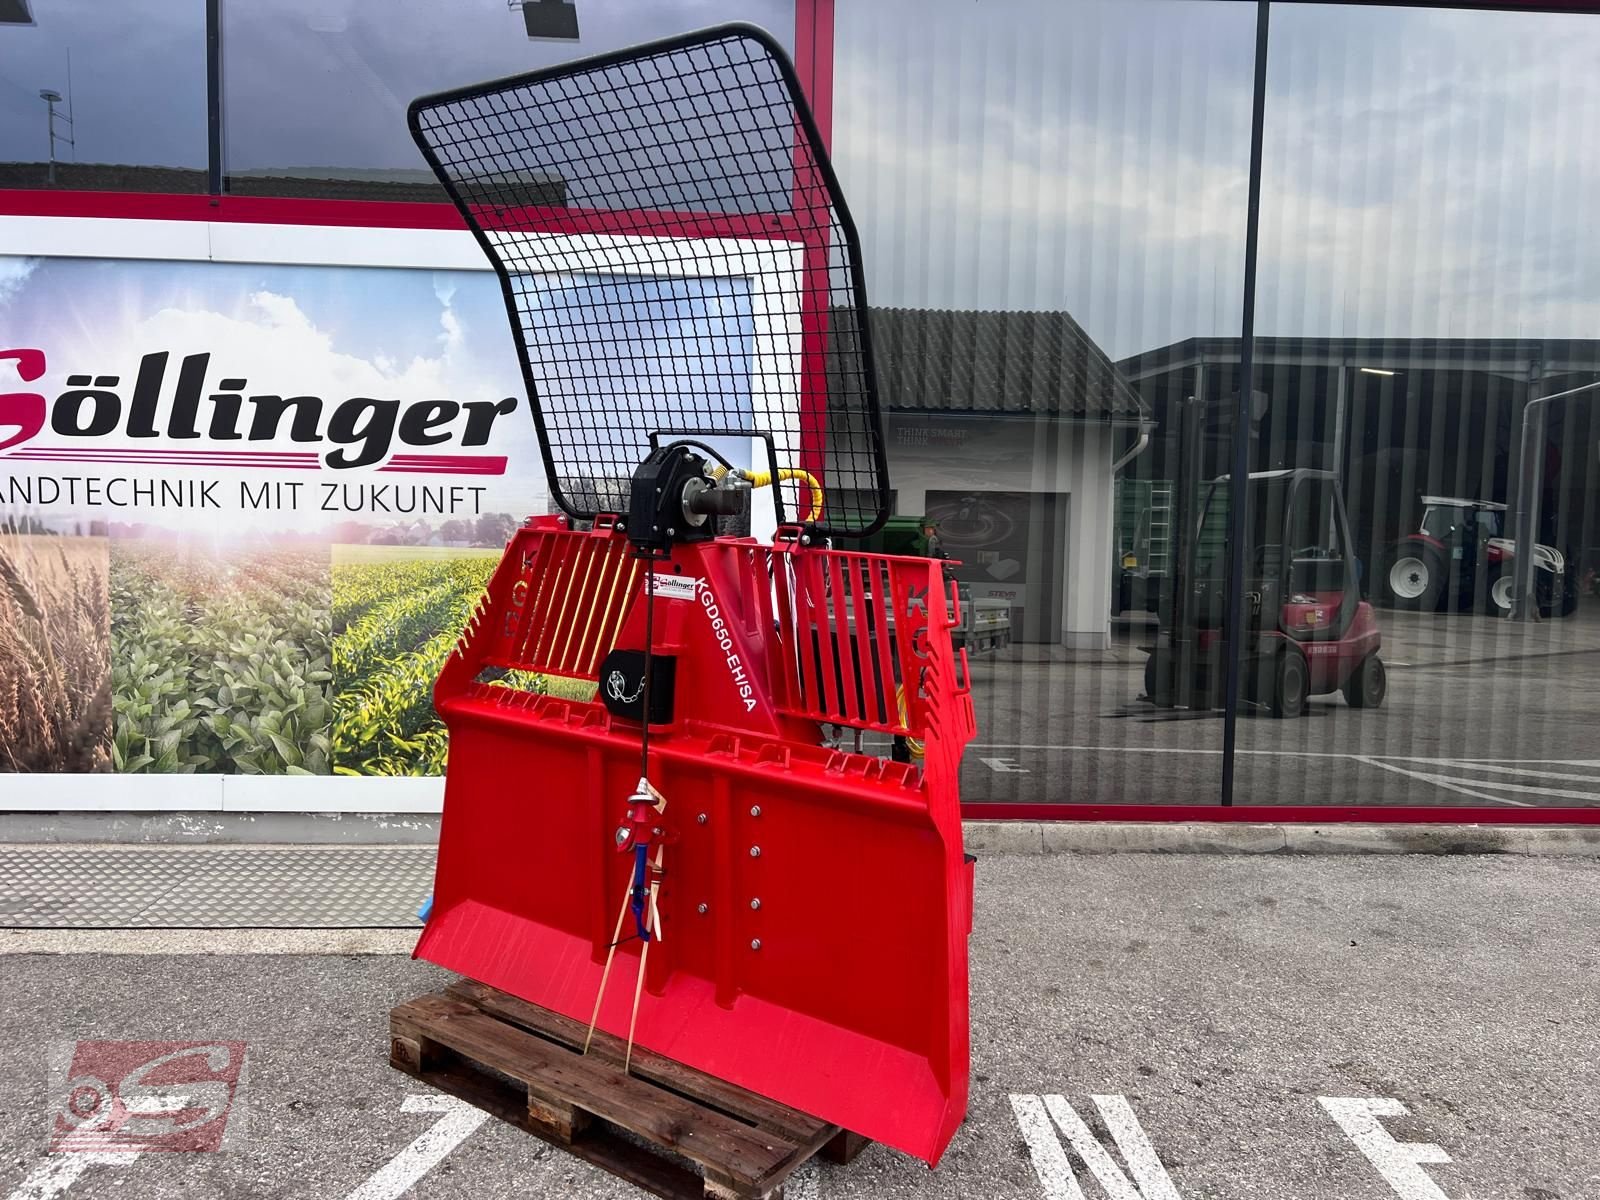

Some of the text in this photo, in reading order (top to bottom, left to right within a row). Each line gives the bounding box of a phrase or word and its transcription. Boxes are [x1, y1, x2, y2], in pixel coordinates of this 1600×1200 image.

[0, 476, 487, 514] NDTECHNIK MIT ZUKUNFT
[695, 576, 757, 712] KGD650-EH/SA
